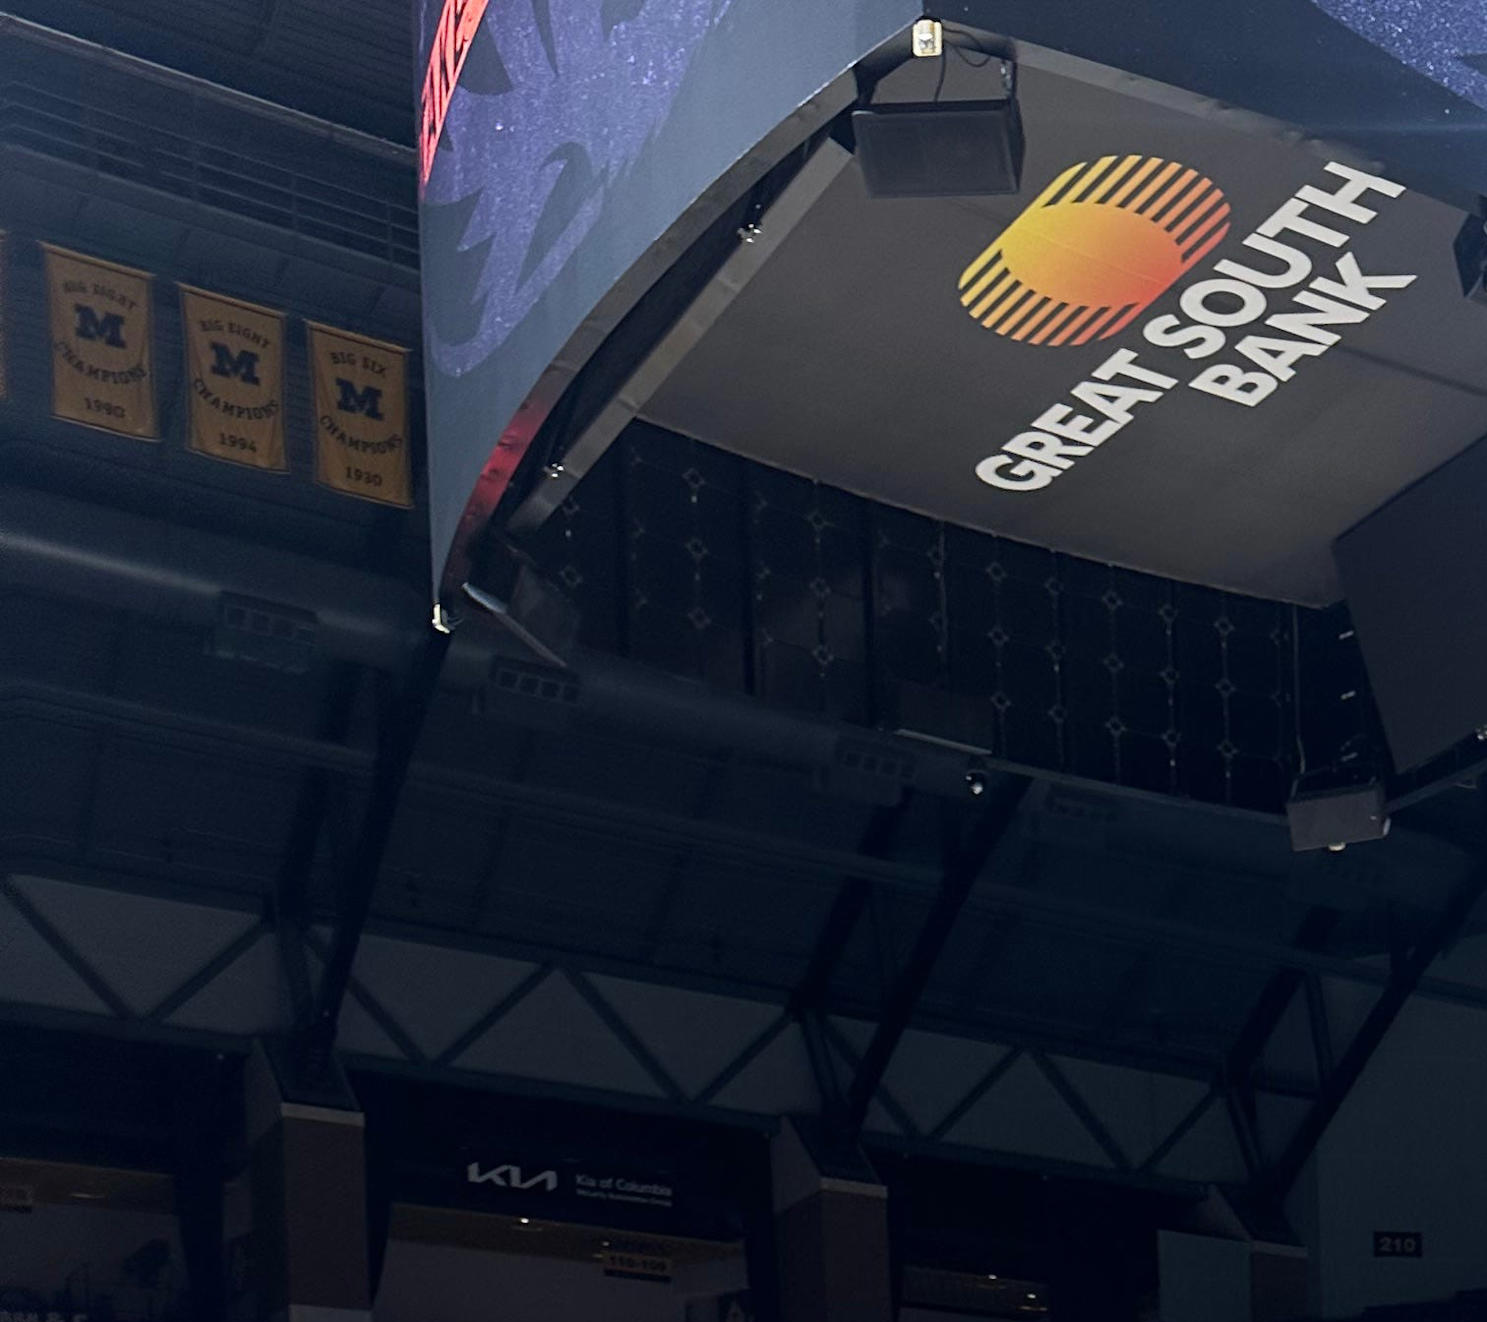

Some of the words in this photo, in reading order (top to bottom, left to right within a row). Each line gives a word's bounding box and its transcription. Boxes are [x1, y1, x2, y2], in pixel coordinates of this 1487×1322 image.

[75, 303, 126, 349] M
[975, 347, 1178, 492] GREAT
[1143, 160, 1407, 360] SOUTH
[1189, 252, 1418, 407] BANK
[210, 340, 261, 387] M
[331, 351, 358, 366] BIG
[362, 356, 388, 376] SIX
[192, 378, 280, 422] CHAMPIONS
[335, 377, 384, 422] M
[1378, 1236, 1417, 1253] 210
